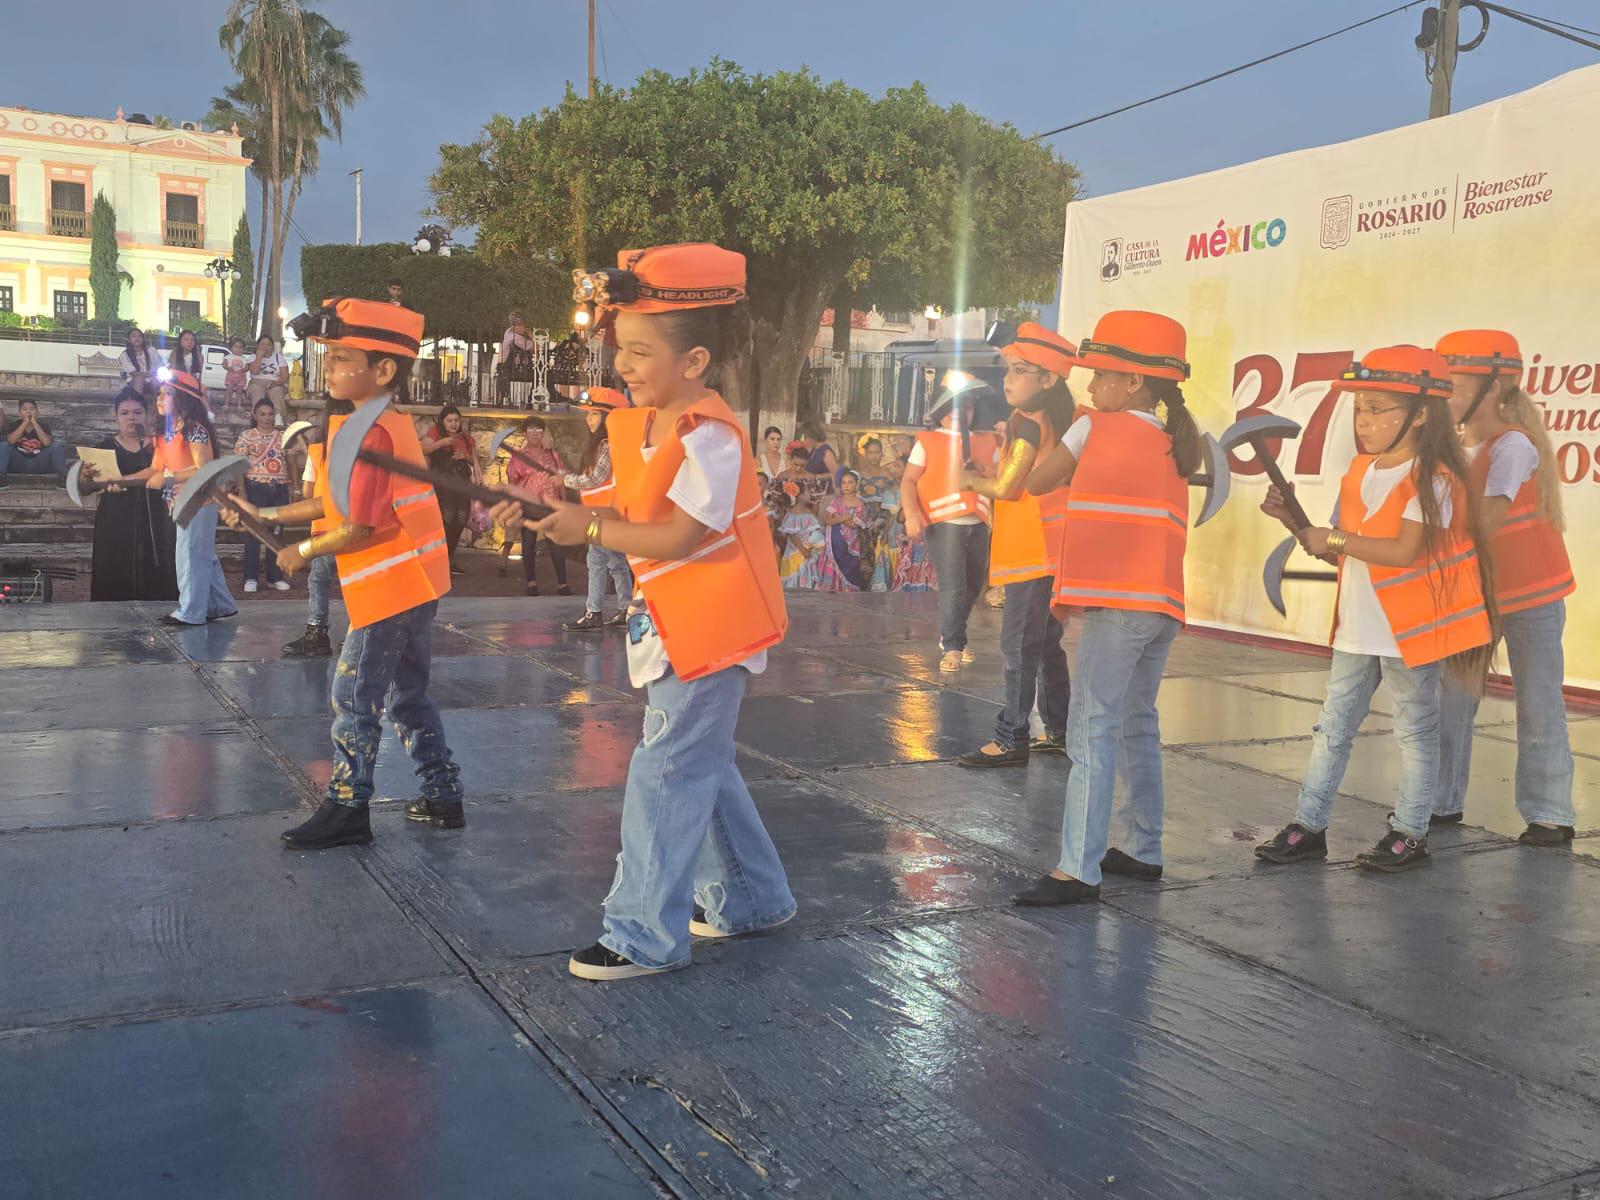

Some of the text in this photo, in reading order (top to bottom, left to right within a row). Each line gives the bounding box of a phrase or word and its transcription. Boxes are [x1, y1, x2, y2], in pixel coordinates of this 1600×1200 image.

[1358, 186, 1449, 210] GOBIERNO DE
[1464, 169, 1549, 202] Bienestar
[1356, 199, 1447, 233] ROSARIO
[1462, 188, 1553, 220] Rosarense
[1125, 248, 1160, 262] CULTURA
[1126, 241, 1144, 251] CASA
[658, 289, 729, 300] HEADLIGHT
[1523, 353, 1600, 396] ive
[1229, 350, 1355, 476] 37
